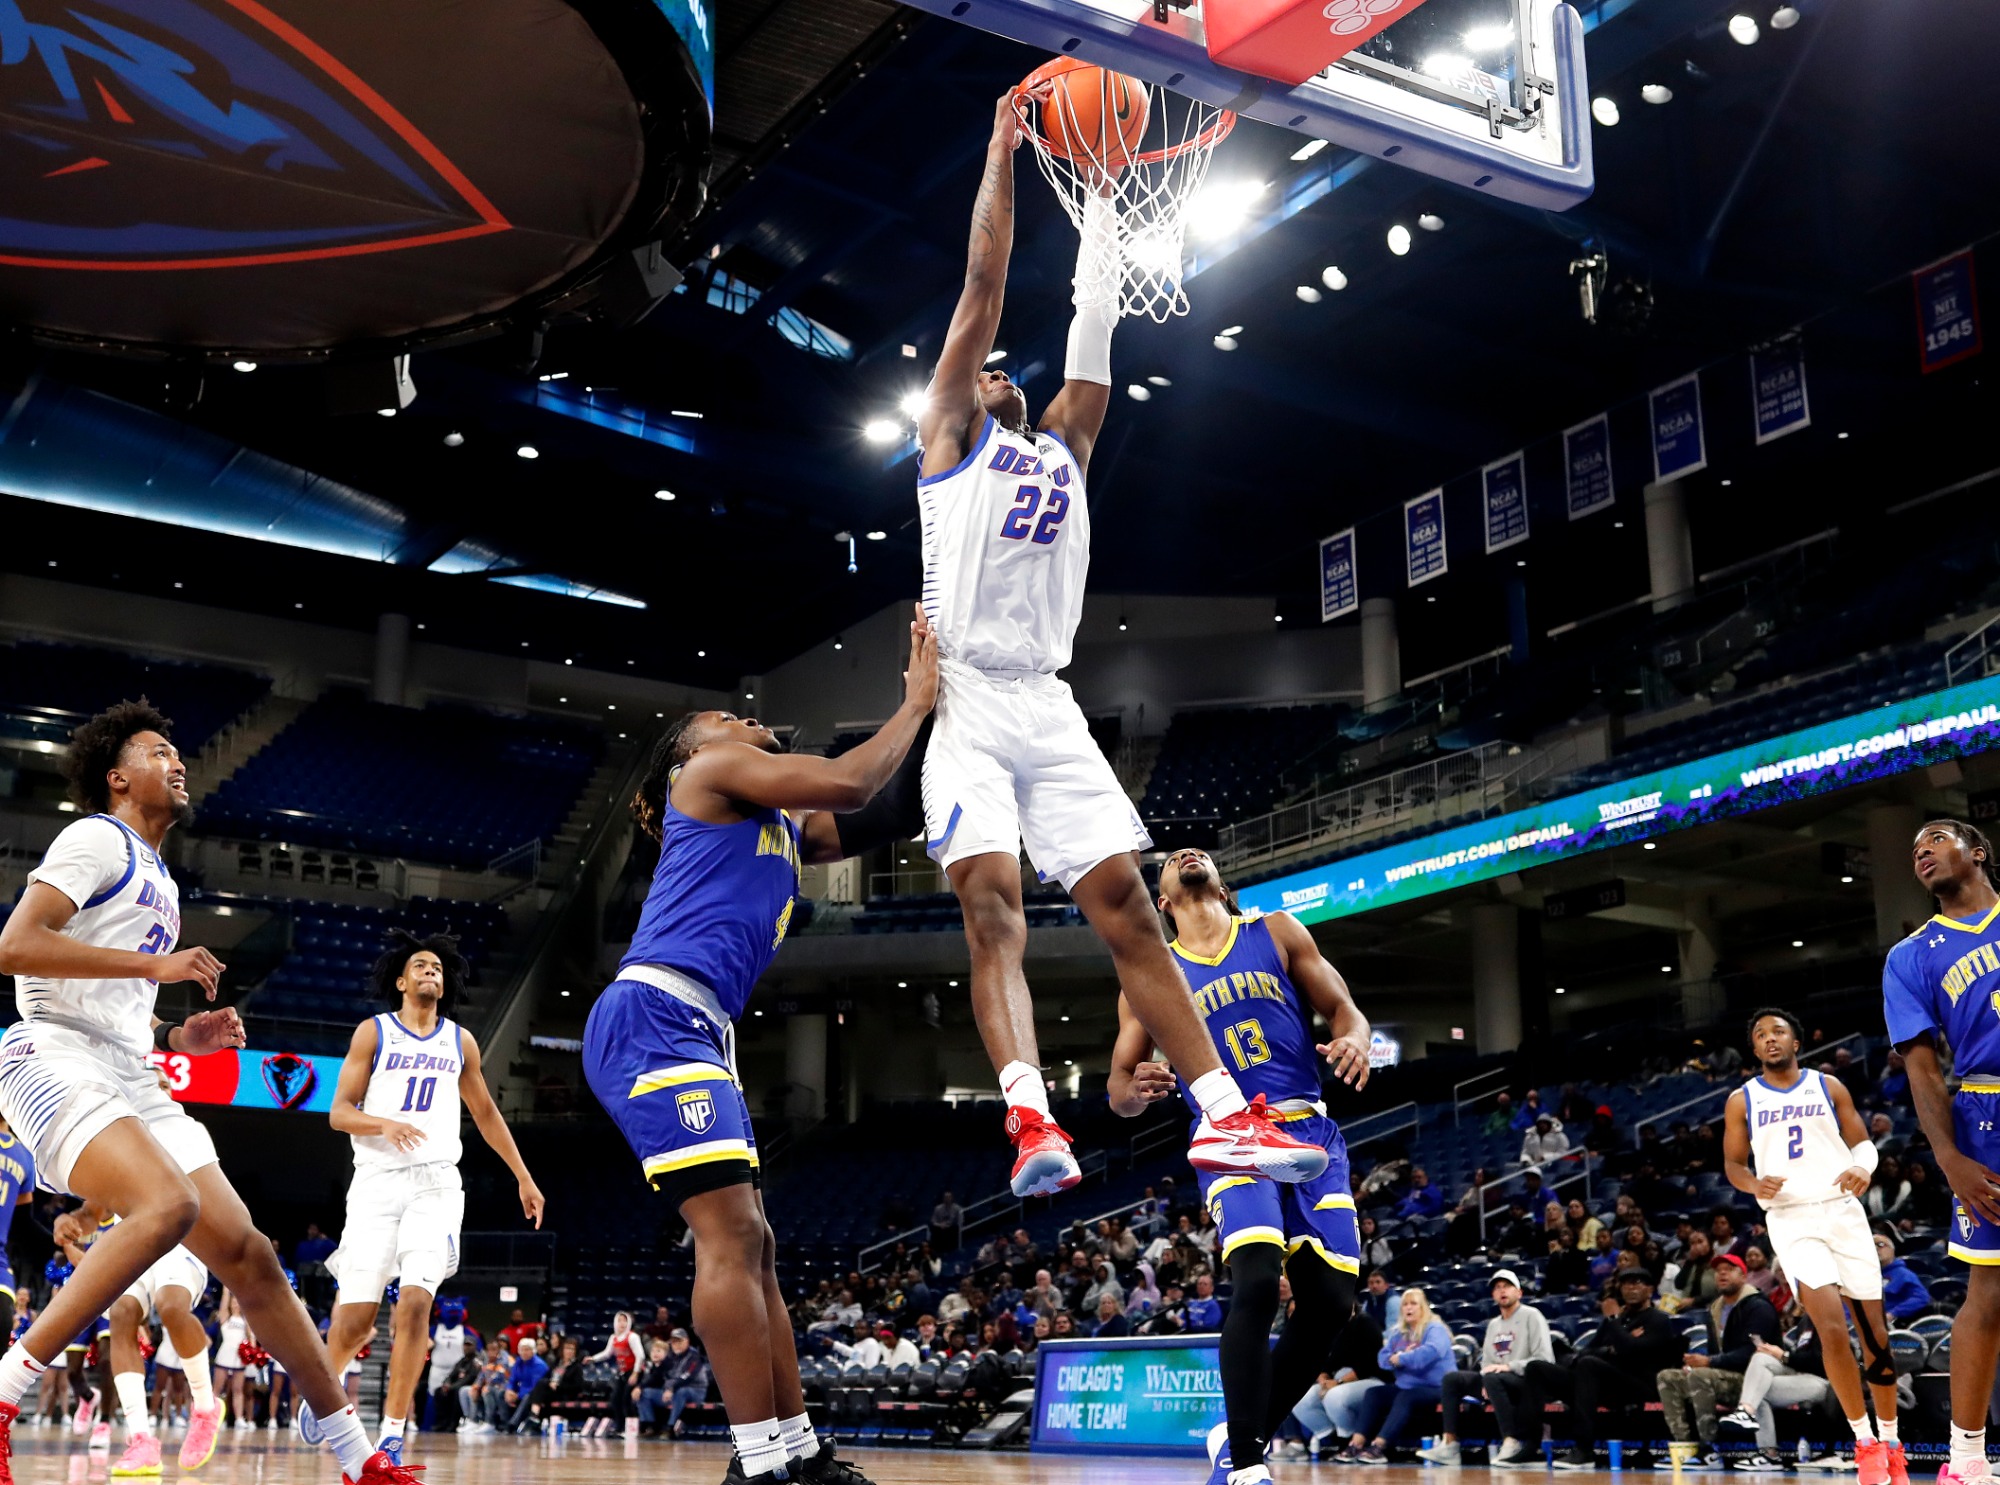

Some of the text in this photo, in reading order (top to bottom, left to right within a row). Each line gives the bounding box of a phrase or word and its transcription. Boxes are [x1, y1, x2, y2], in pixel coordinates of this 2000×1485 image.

[1926, 318, 1973, 352] 1945
[1760, 369, 1796, 393] NCAA
[1659, 411, 1694, 436] NCAA
[1490, 487, 1519, 509] NCAA
[1000, 484, 1071, 545] 22
[1412, 523, 1438, 545] NCAA
[1326, 560, 1350, 581] NCAA
[1740, 703, 2000, 788] WINTRUST.COM/DEPAUL
[1598, 791, 1663, 816] WINTRUST
[1384, 822, 1575, 884] WINTRUST.COM/DEPAUL
[1193, 970, 1287, 1019] RTH PARK
[1223, 1018, 1272, 1072] 13
[400, 1076, 438, 1112] 10
[681, 1100, 712, 1130] NP
[1788, 1125, 1804, 1160] 2
[1057, 1363, 1125, 1392] CHICAGO'S
[1047, 1403, 1128, 1430] HOME TEAM!
